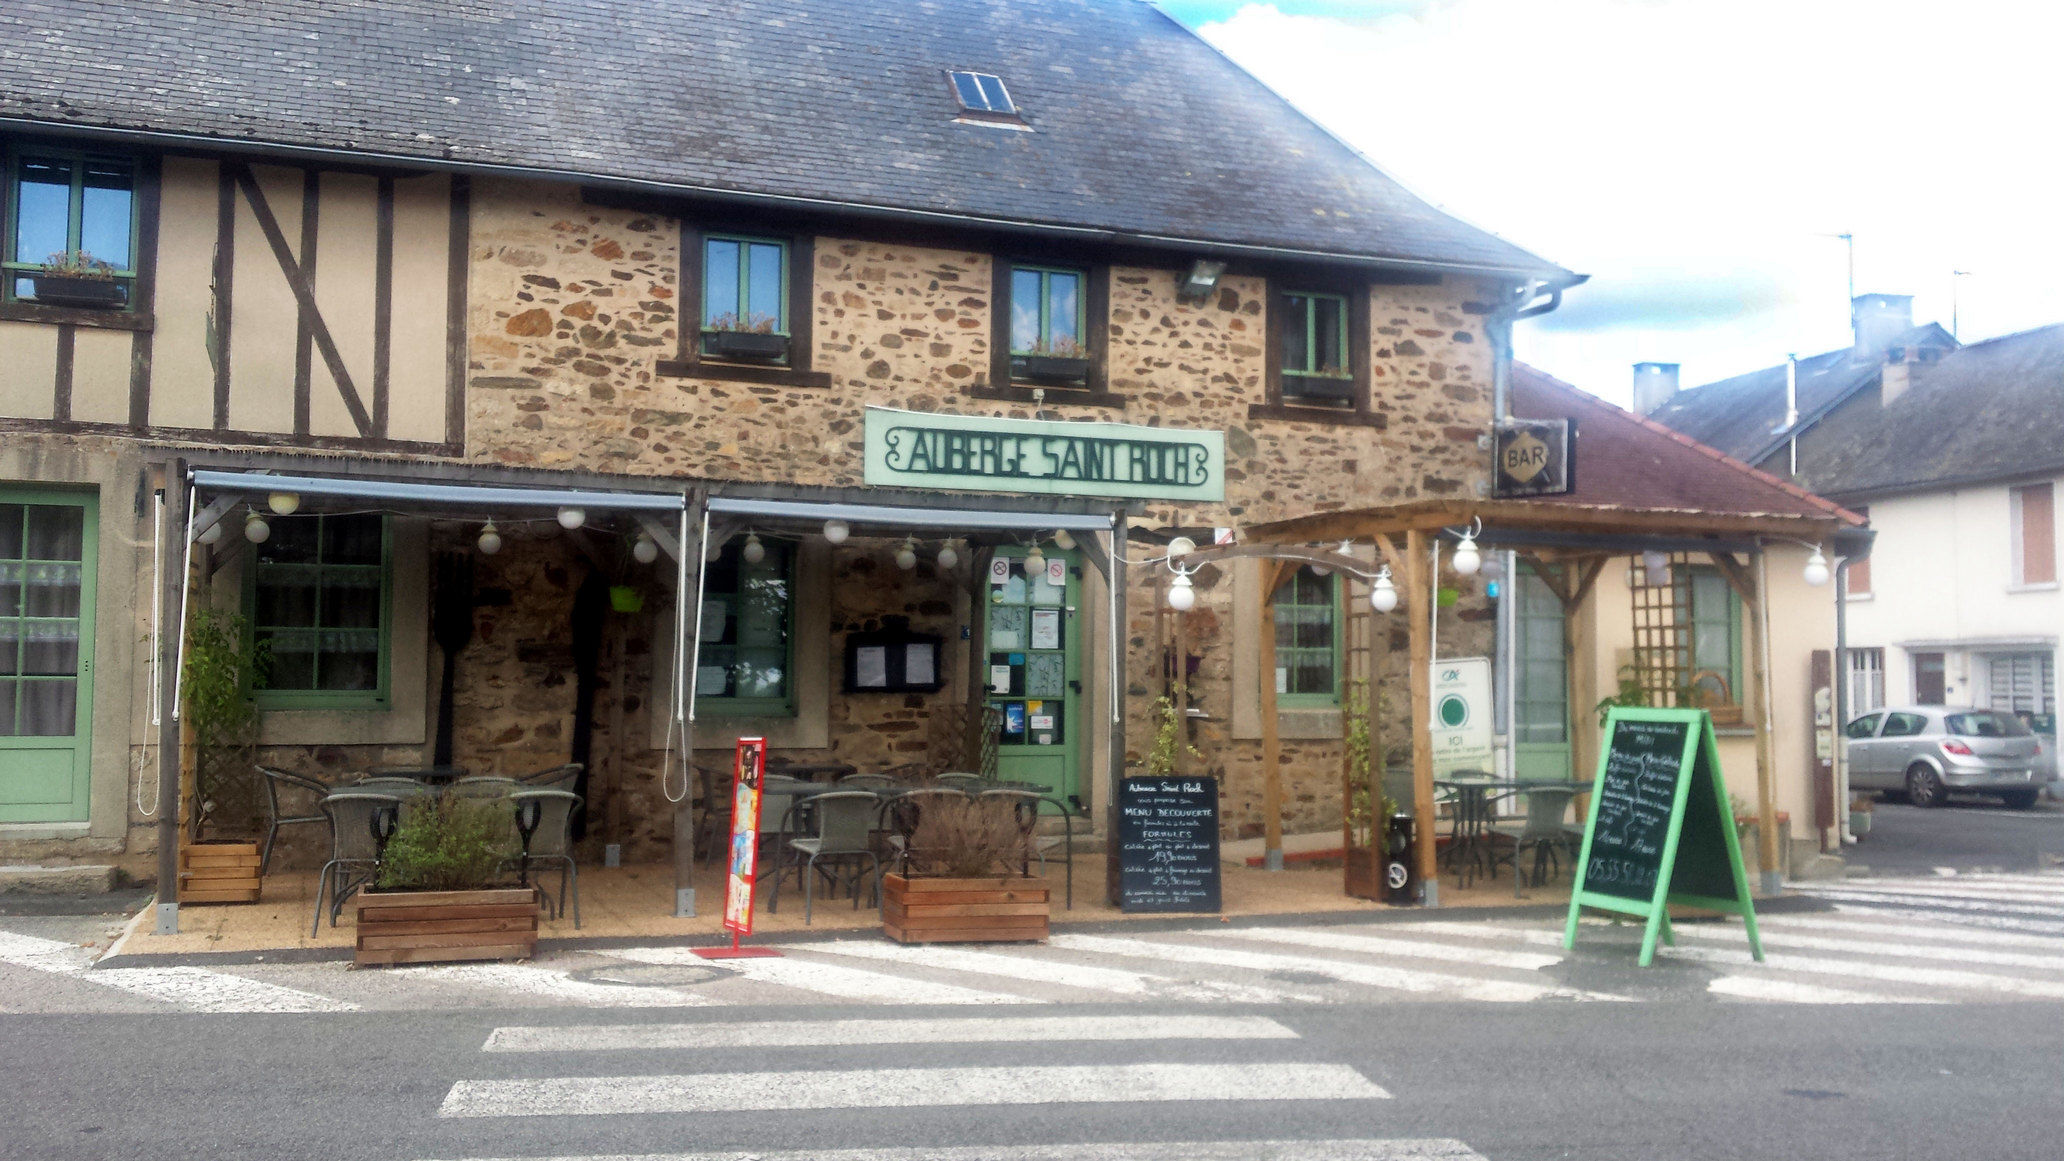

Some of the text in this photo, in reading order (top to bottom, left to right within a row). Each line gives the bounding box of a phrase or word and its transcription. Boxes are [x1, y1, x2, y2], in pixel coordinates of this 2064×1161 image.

[908, 430, 1190, 485] AUBERGE SAINT ROCH
[1508, 446, 1545, 468] BAR
[1125, 807, 1152, 817] MENU
[1142, 831, 1193, 839] FORMULES
